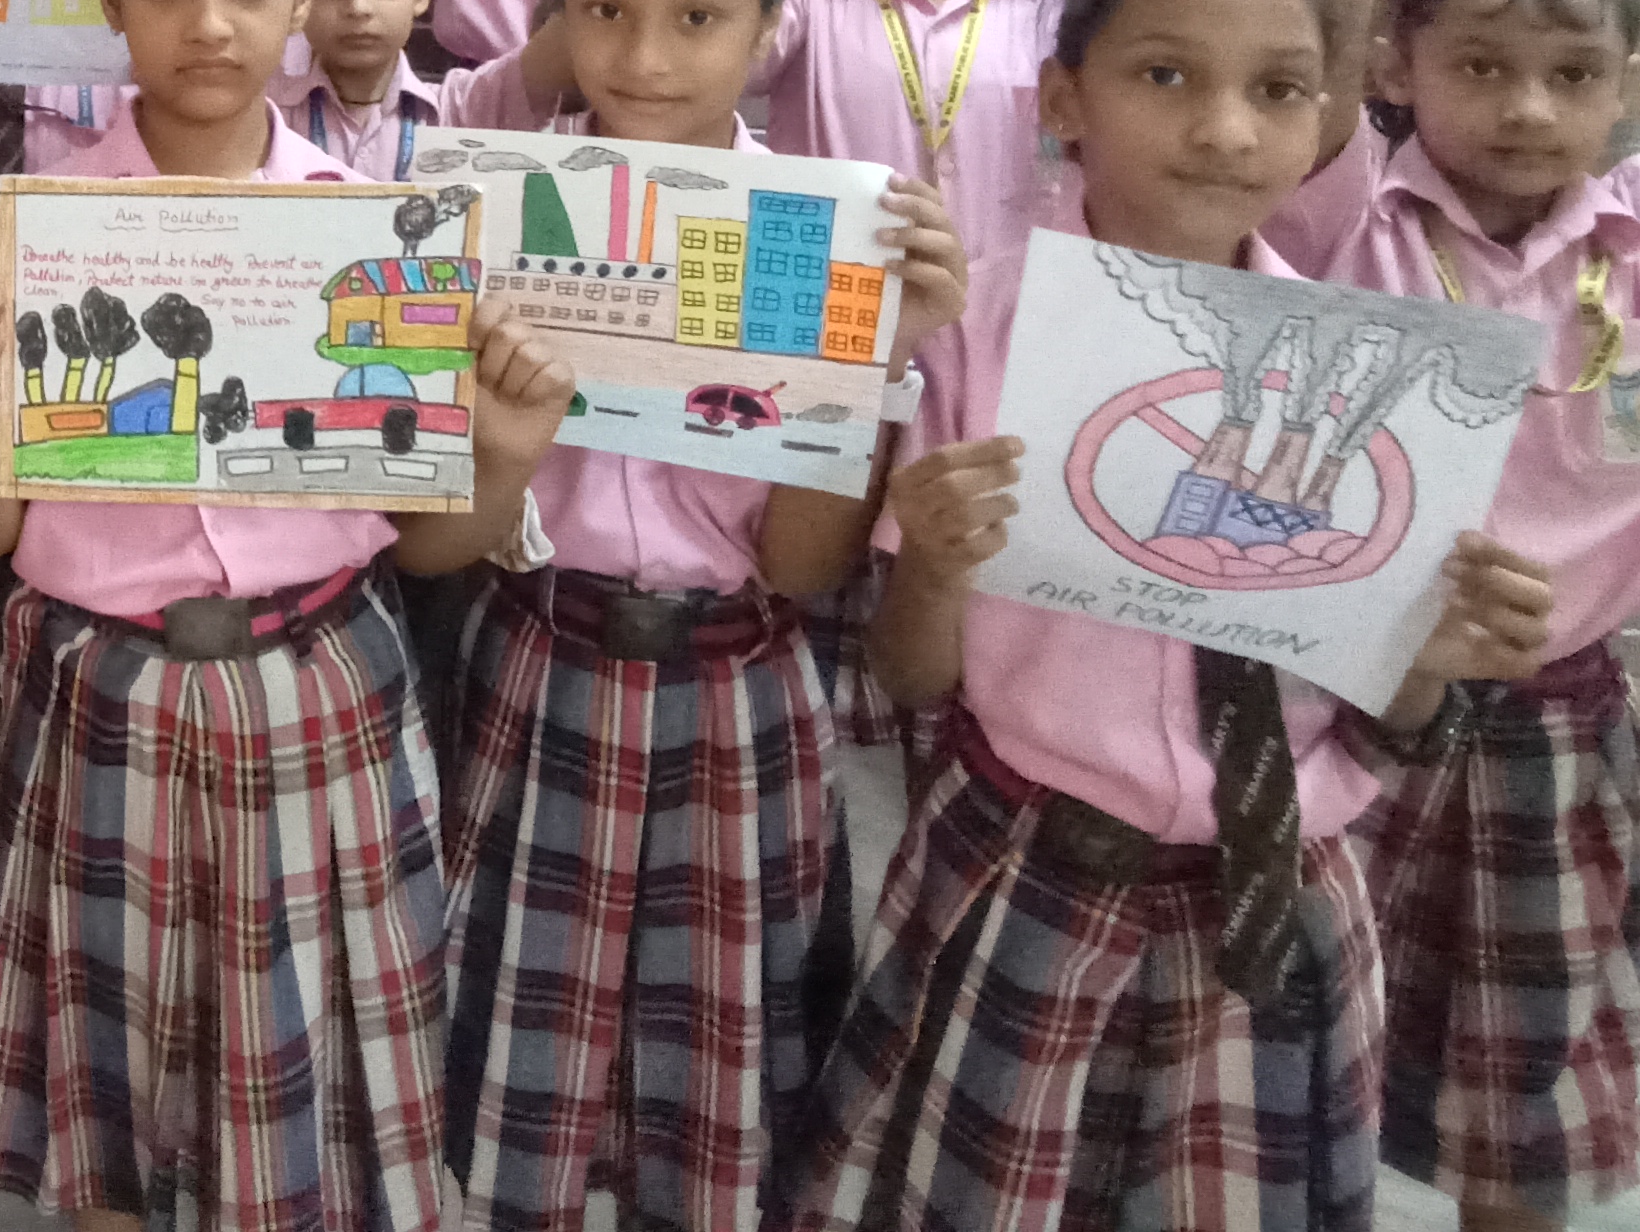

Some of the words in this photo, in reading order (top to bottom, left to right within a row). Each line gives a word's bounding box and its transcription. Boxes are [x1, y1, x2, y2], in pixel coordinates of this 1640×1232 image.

[114, 207, 145, 223] Air
[20, 244, 76, 265] Breathe
[82, 249, 132, 273] healthy
[135, 250, 160, 267] and
[164, 251, 186, 269] be
[210, 275, 252, 292] green
[200, 293, 226, 311] Say
[230, 296, 247, 308] no
[249, 296, 267, 308] to
[270, 296, 298, 309] air
[1025, 579, 1099, 612] AIR
[1110, 575, 1209, 609] STOP
